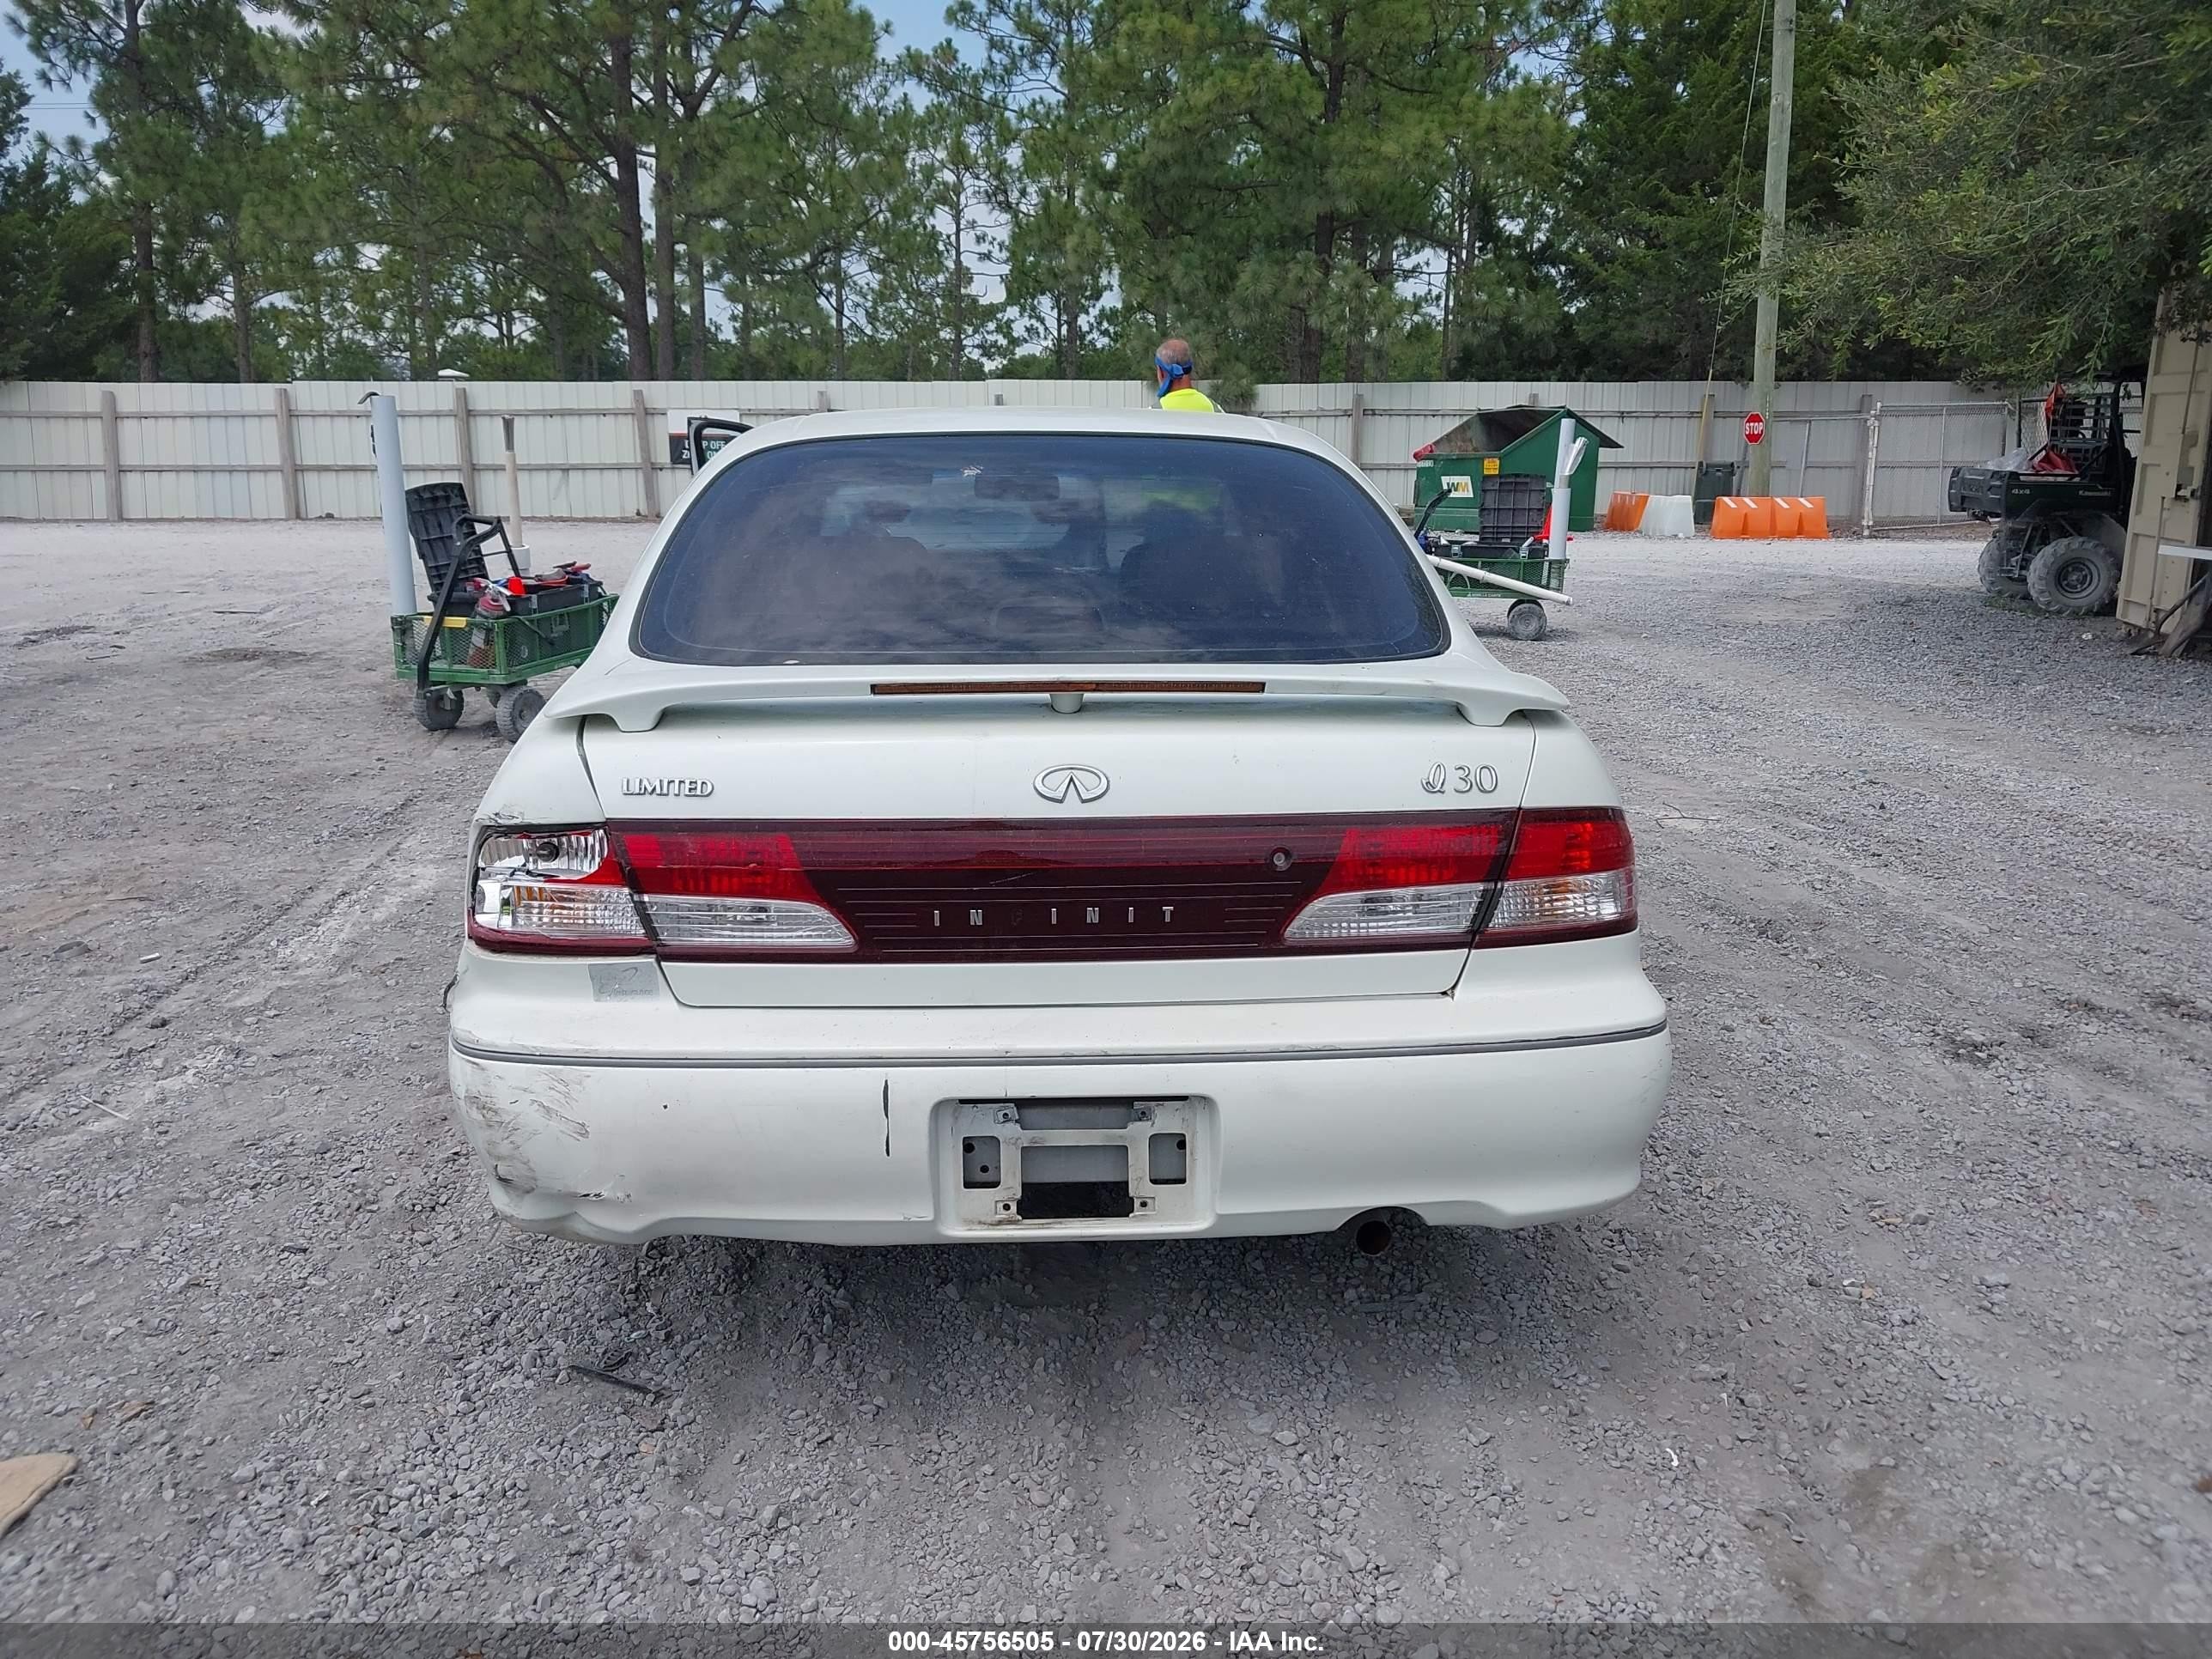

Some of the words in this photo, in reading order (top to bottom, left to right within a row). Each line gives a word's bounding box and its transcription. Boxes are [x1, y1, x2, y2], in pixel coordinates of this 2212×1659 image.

[1745, 422, 1764, 434] STOP
[684, 440, 708, 449] DP
[1447, 482, 1469, 492] WM
[622, 776, 714, 797] LIMITED
